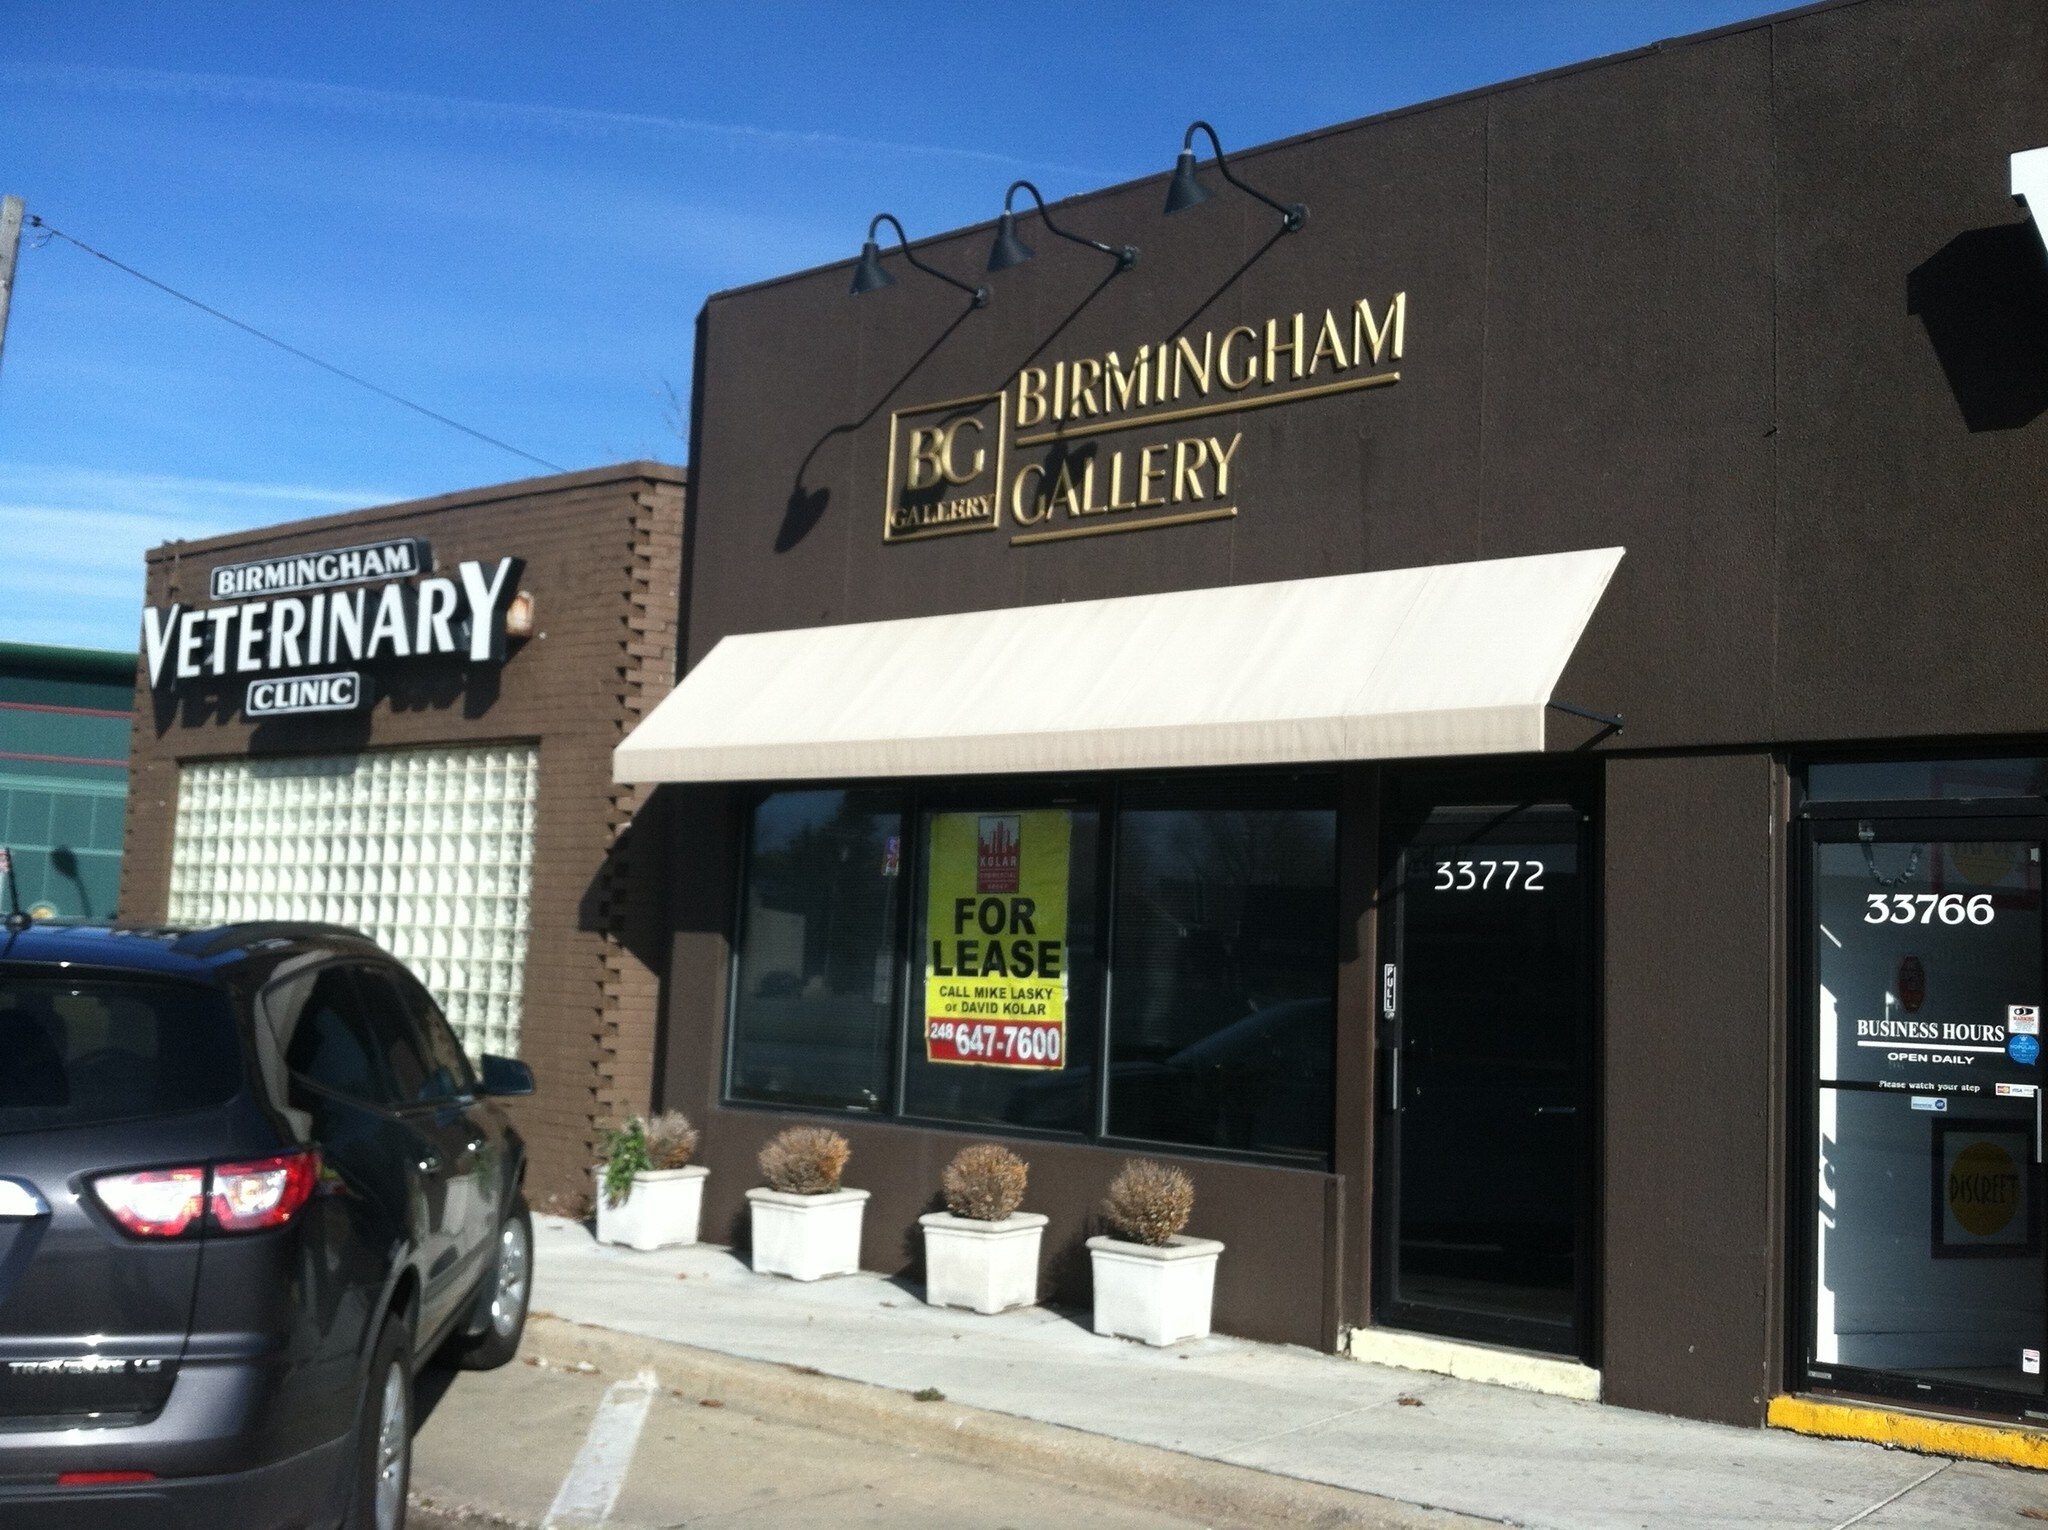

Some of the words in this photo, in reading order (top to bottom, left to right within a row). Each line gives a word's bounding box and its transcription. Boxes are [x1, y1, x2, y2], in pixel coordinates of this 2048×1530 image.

[1014, 290, 1407, 427] BIRMINGHAM
[906, 417, 985, 491] BG
[1012, 432, 1242, 526] GALLERY
[890, 494, 996, 527] GALLERY
[216, 544, 411, 596] BIRMINGHAM
[143, 556, 513, 690] VETERINARY
[253, 677, 353, 710] CLINIC
[1434, 861, 1545, 890] 33772
[954, 897, 1036, 935] FOR
[1863, 893, 1995, 925] 33766
[933, 940, 1061, 978] LEASE
[939, 985, 970, 998] CALL
[974, 986, 1007, 999] MIKE
[1010, 987, 1053, 1000] LASKY
[1386, 966, 1394, 1009] PULL
[945, 1002, 957, 1012] or
[961, 1001, 998, 1014] DAVID
[1002, 1002, 1046, 1015] KOLAR
[930, 1022, 954, 1039] 248
[955, 1023, 1060, 1060] 647-7600
[1857, 1019, 1938, 1039] BUSINESS
[1942, 1022, 2005, 1042] HOURS
[1887, 1052, 1928, 1063] OPEN
[1932, 1054, 1975, 1065] DAILY
[1879, 1080, 1906, 1089] Please
[1909, 1082, 1935, 1090] watch
[1937, 1083, 1958, 1092] your
[1961, 1084, 1981, 1093] step
